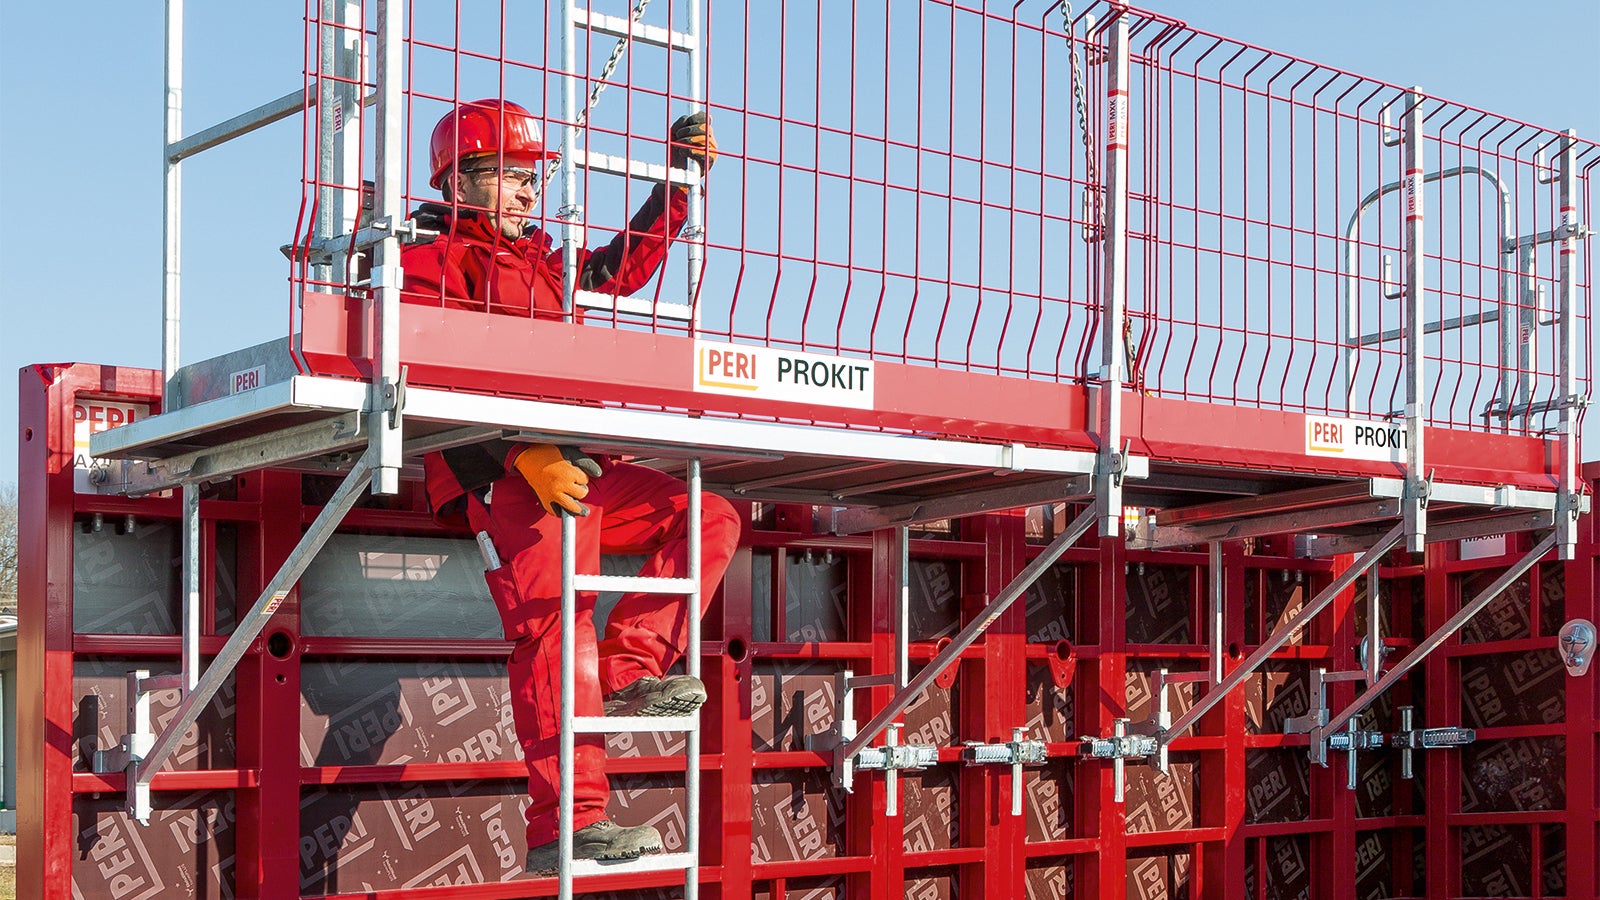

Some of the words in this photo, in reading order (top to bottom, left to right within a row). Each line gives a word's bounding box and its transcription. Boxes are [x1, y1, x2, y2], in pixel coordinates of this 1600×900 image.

[334, 106, 342, 131] PERI
[1108, 122, 1116, 139] PERI
[236, 369, 258, 392] PERI
[708, 349, 756, 380] PERI
[777, 357, 870, 391] PROKIT
[1314, 421, 1343, 444] PERI
[1468, 673, 1508, 726] PERI
[332, 701, 402, 761] PERI
[1153, 773, 1183, 826] PERI
[1252, 764, 1288, 808] PERI
[82, 815, 146, 900] PERI
[300, 807, 368, 871] PERI
